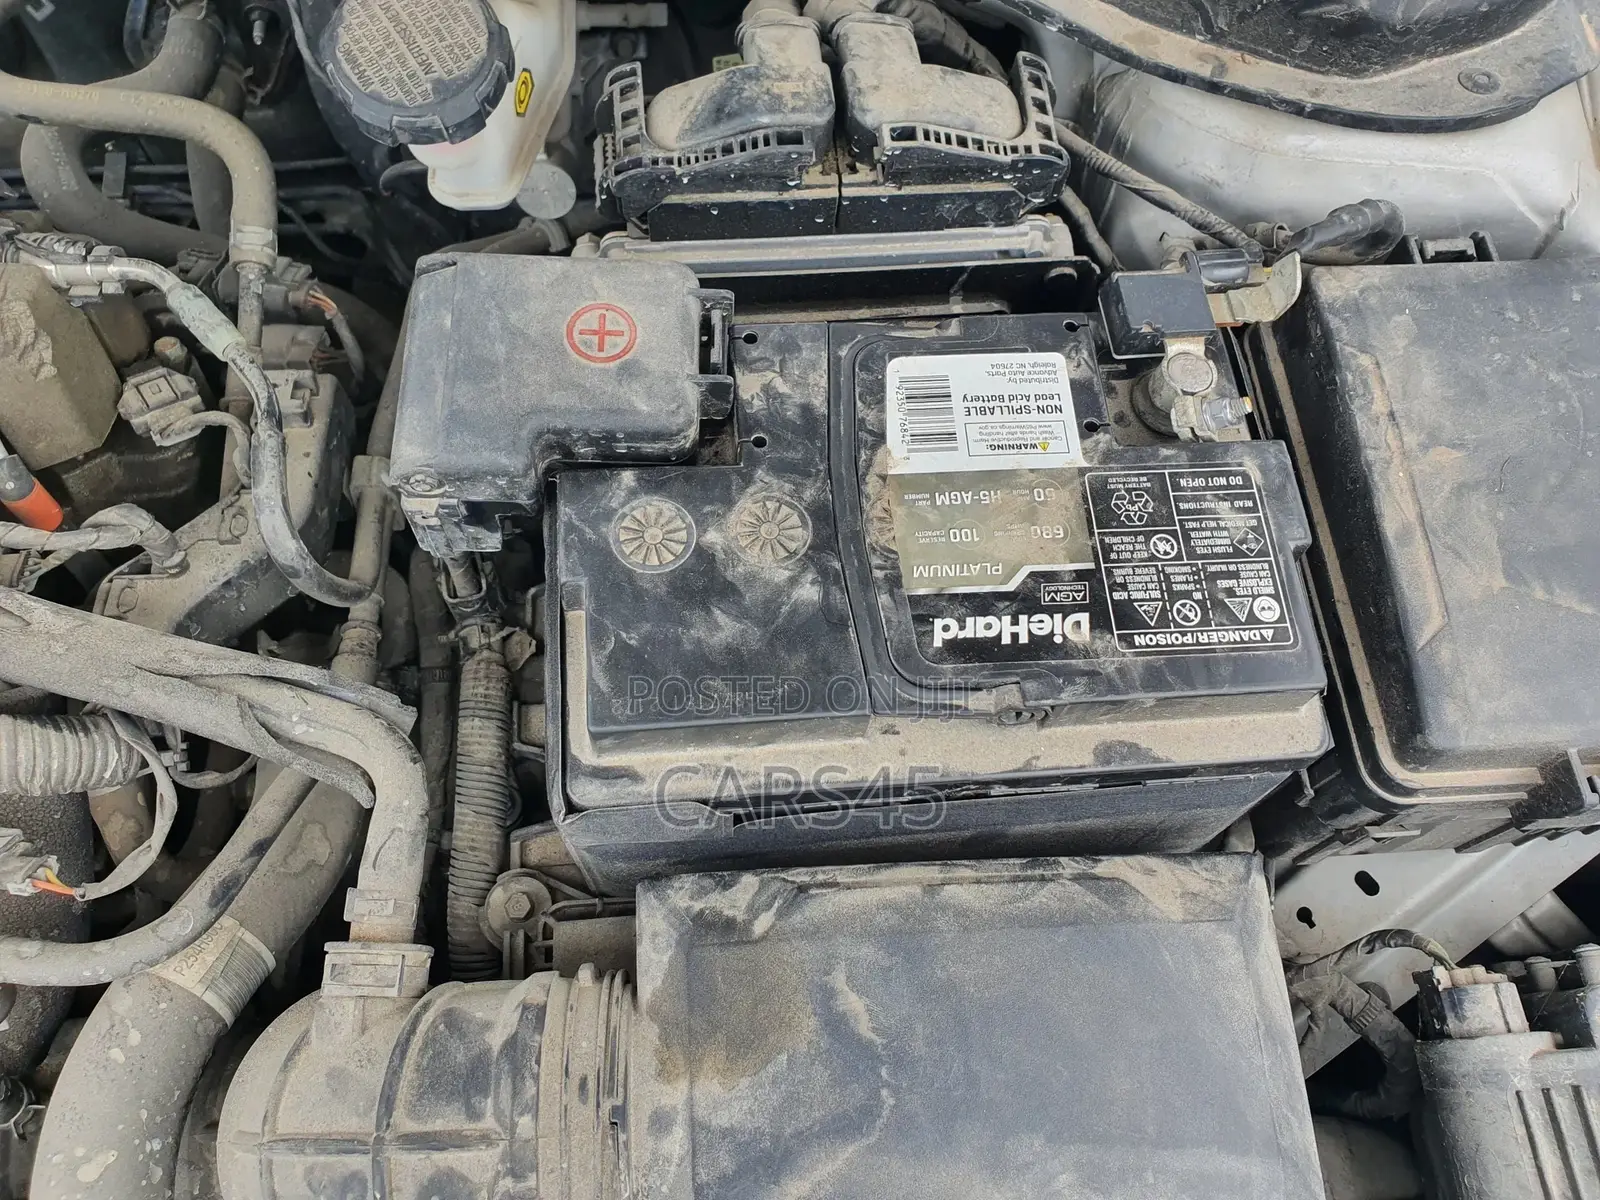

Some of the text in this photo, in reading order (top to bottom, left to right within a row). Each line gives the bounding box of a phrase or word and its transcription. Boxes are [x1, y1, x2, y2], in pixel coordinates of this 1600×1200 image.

[375, 23, 397, 50] SEALED
[377, 0, 437, 79] AVERTISSEMENT
[371, 41, 389, 61] ONLY
[336, 40, 375, 91] WARNING
[364, 54, 385, 79] FILLER
[381, 56, 397, 74] USE
[404, 67, 424, 90] FLUID
[377, 74, 399, 99] CLEAN
[896, 384, 906, 412] 92350
[962, 393, 1061, 403] Lead Acid Battery
[964, 405, 1063, 416] NON-SPILLABLE
[899, 417, 909, 444] 76842
[1208, 477, 1227, 486] NOT
[1229, 476, 1243, 485] DO
[935, 490, 1002, 505] H5-AGM
[949, 528, 979, 542] 100
[1030, 525, 1064, 538] 680
[1190, 538, 1231, 546] IMMEDIATELY
[1196, 546, 1211, 554] EYES
[913, 562, 1002, 577] PLATINUM
[1125, 574, 1158, 582] BLINDNESS
[1170, 574, 1193, 582] FLAMES
[1217, 578, 1273, 588] EXPLOSIVE GASES
[1044, 591, 1085, 601] AGM
[1112, 590, 1161, 600] SULFURIC ACID
[1193, 592, 1202, 600] NO
[1253, 586, 1275, 594] SHIELD
[1134, 630, 1261, 646] DANGER/POISON
